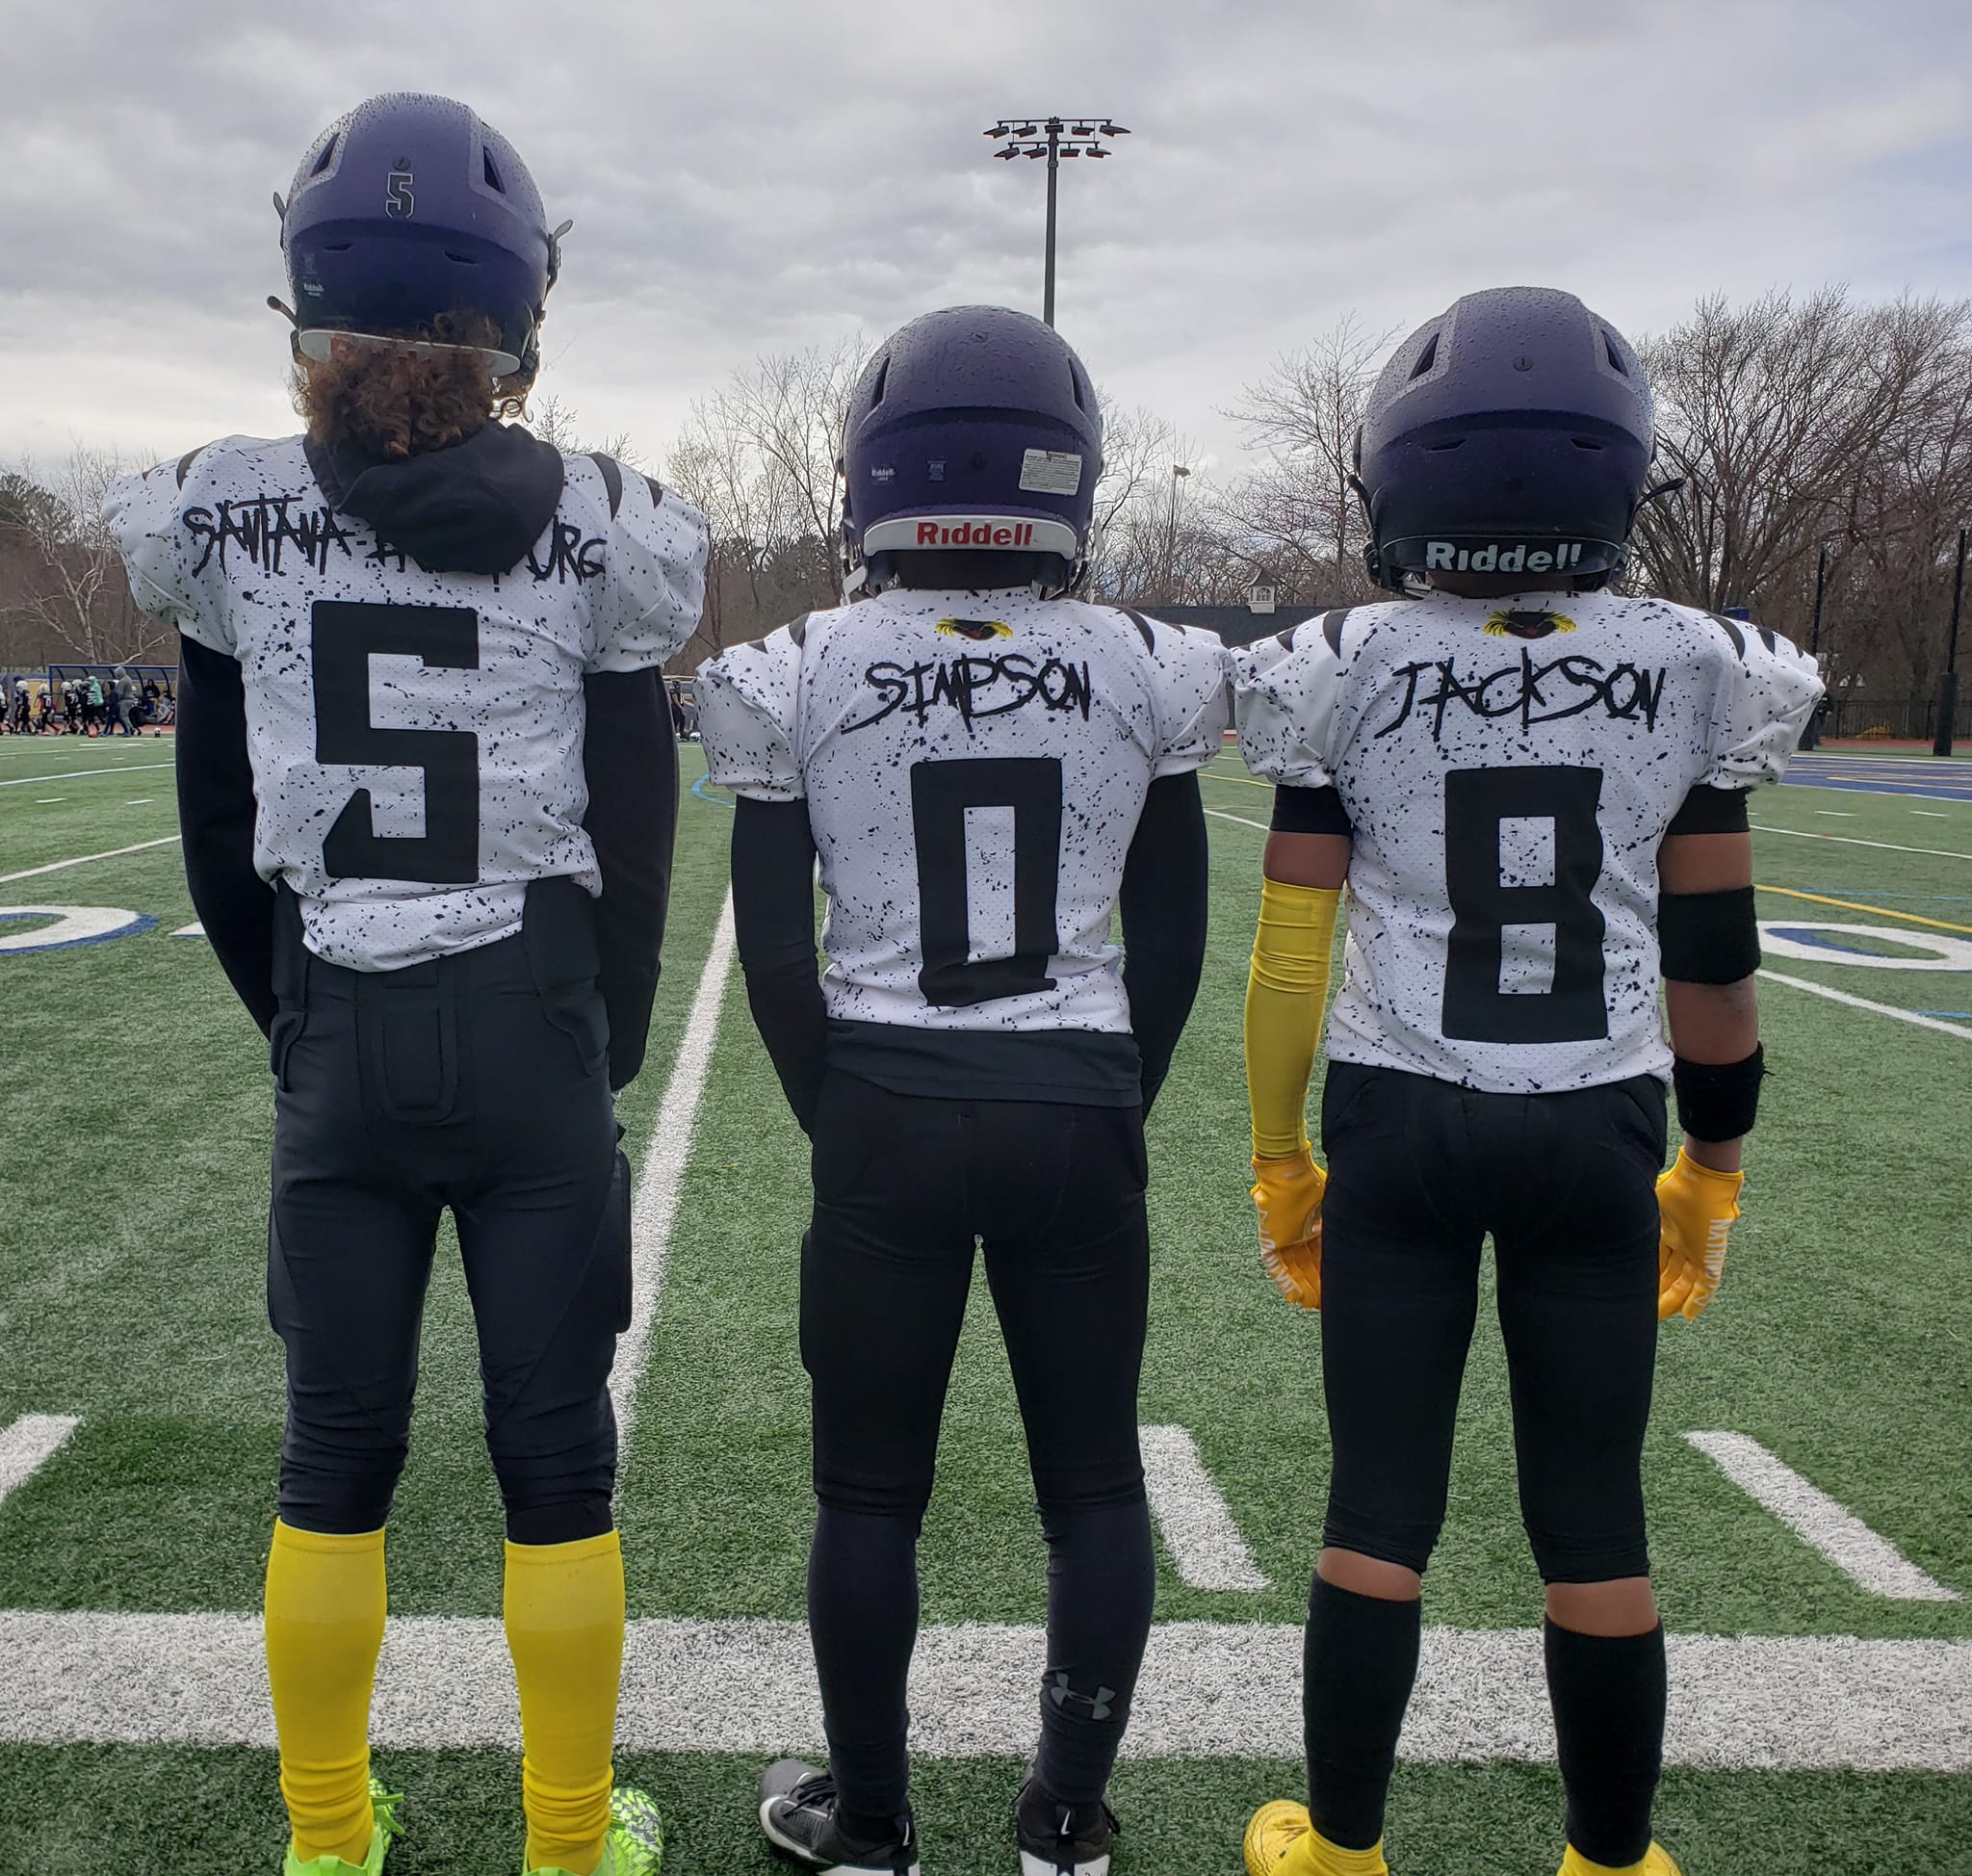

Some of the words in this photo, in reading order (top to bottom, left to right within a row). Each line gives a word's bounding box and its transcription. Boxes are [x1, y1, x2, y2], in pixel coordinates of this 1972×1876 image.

[386, 172, 414, 219] 5
[917, 521, 1033, 546] Riddell
[1426, 541, 1582, 572] Riddell
[841, 653, 1091, 736] SIMPSON
[1374, 646, 1667, 742] JACKSON
[311, 600, 480, 883] 5
[911, 757, 1063, 1007] 0
[1441, 765, 1609, 1043] 8
